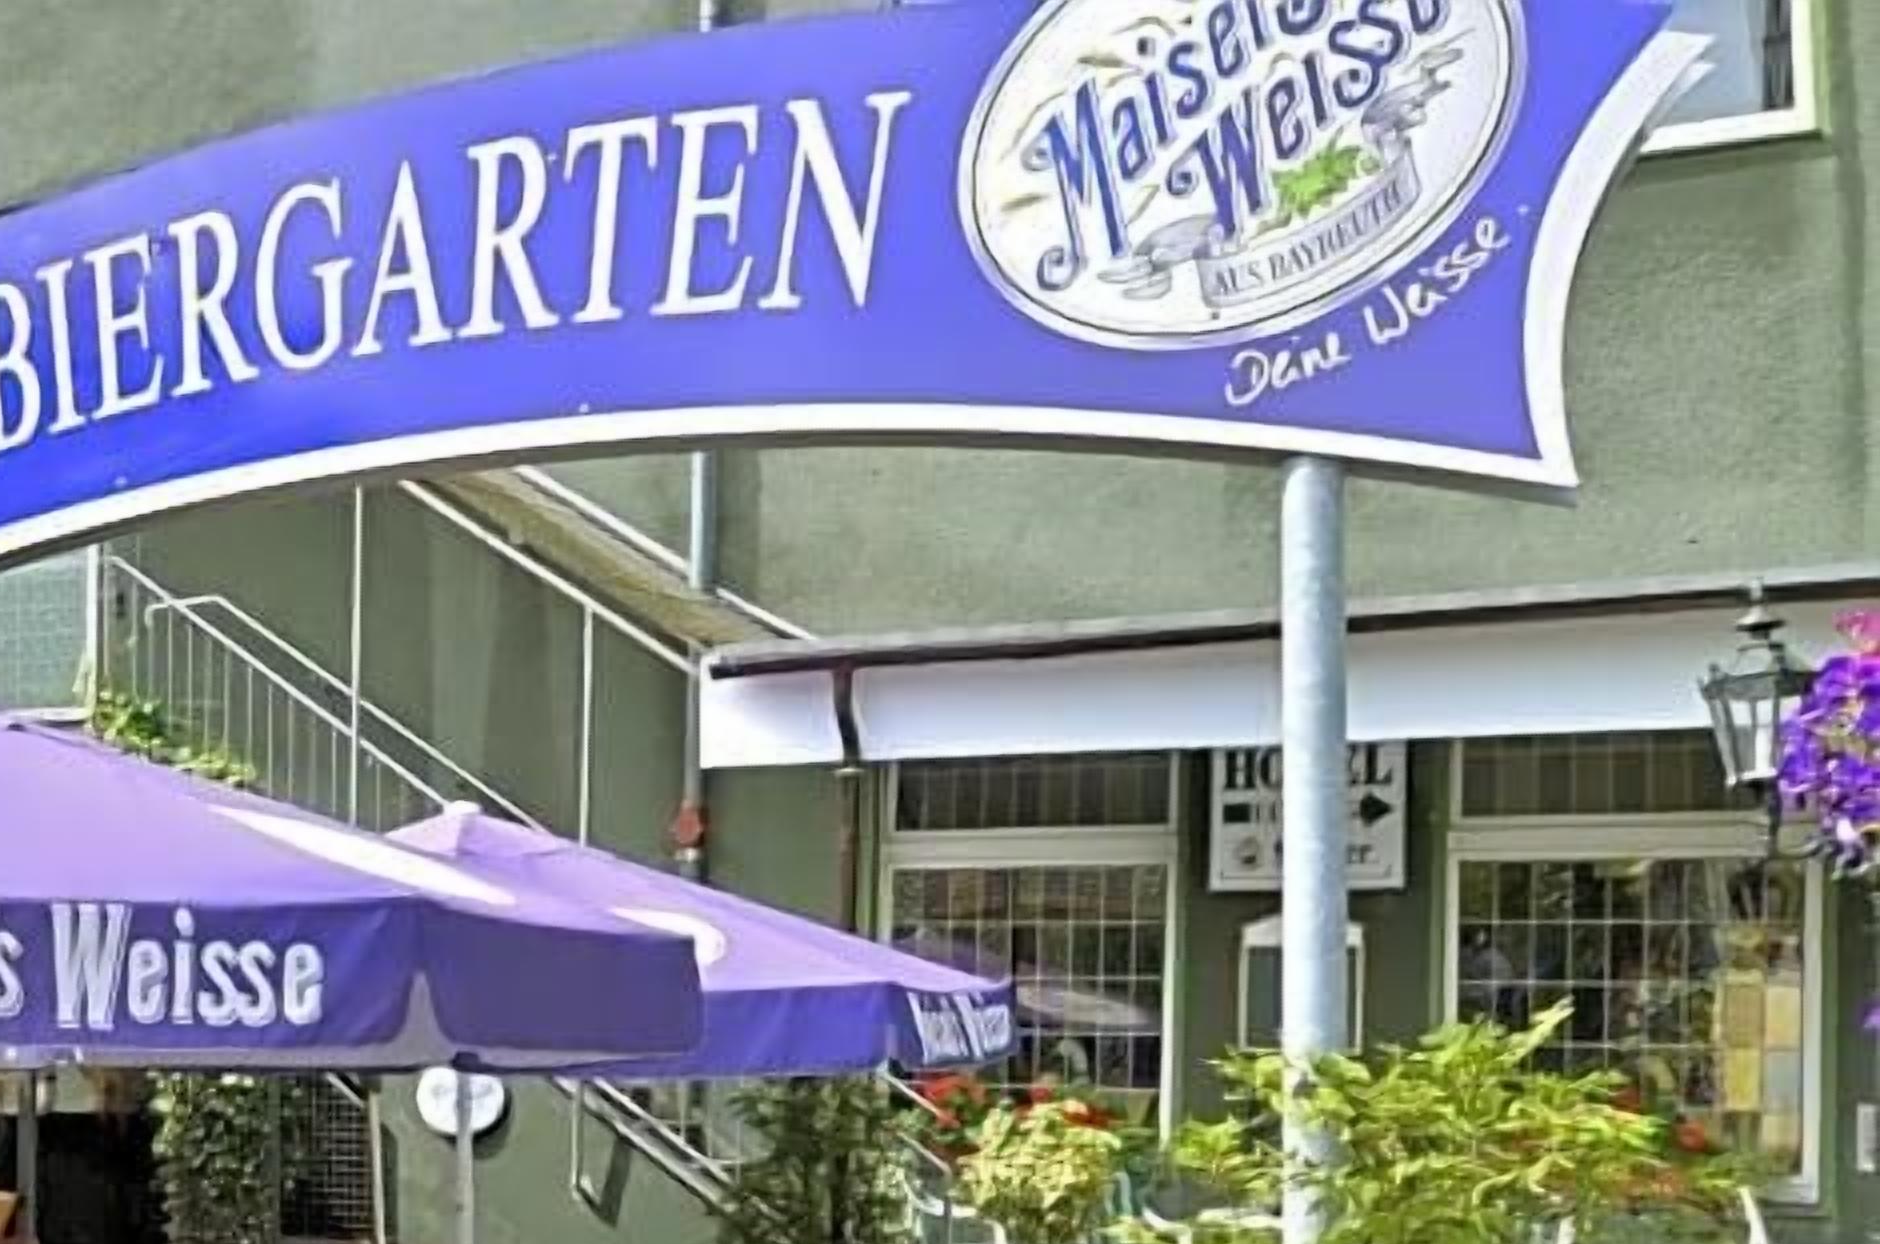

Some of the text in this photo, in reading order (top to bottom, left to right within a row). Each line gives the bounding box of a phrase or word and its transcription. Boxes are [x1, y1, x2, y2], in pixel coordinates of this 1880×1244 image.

[1225, 217, 1510, 406] Deine Weisse
[1223, 745, 1393, 790] HOL
[50, 902, 325, 1030] Weisse
